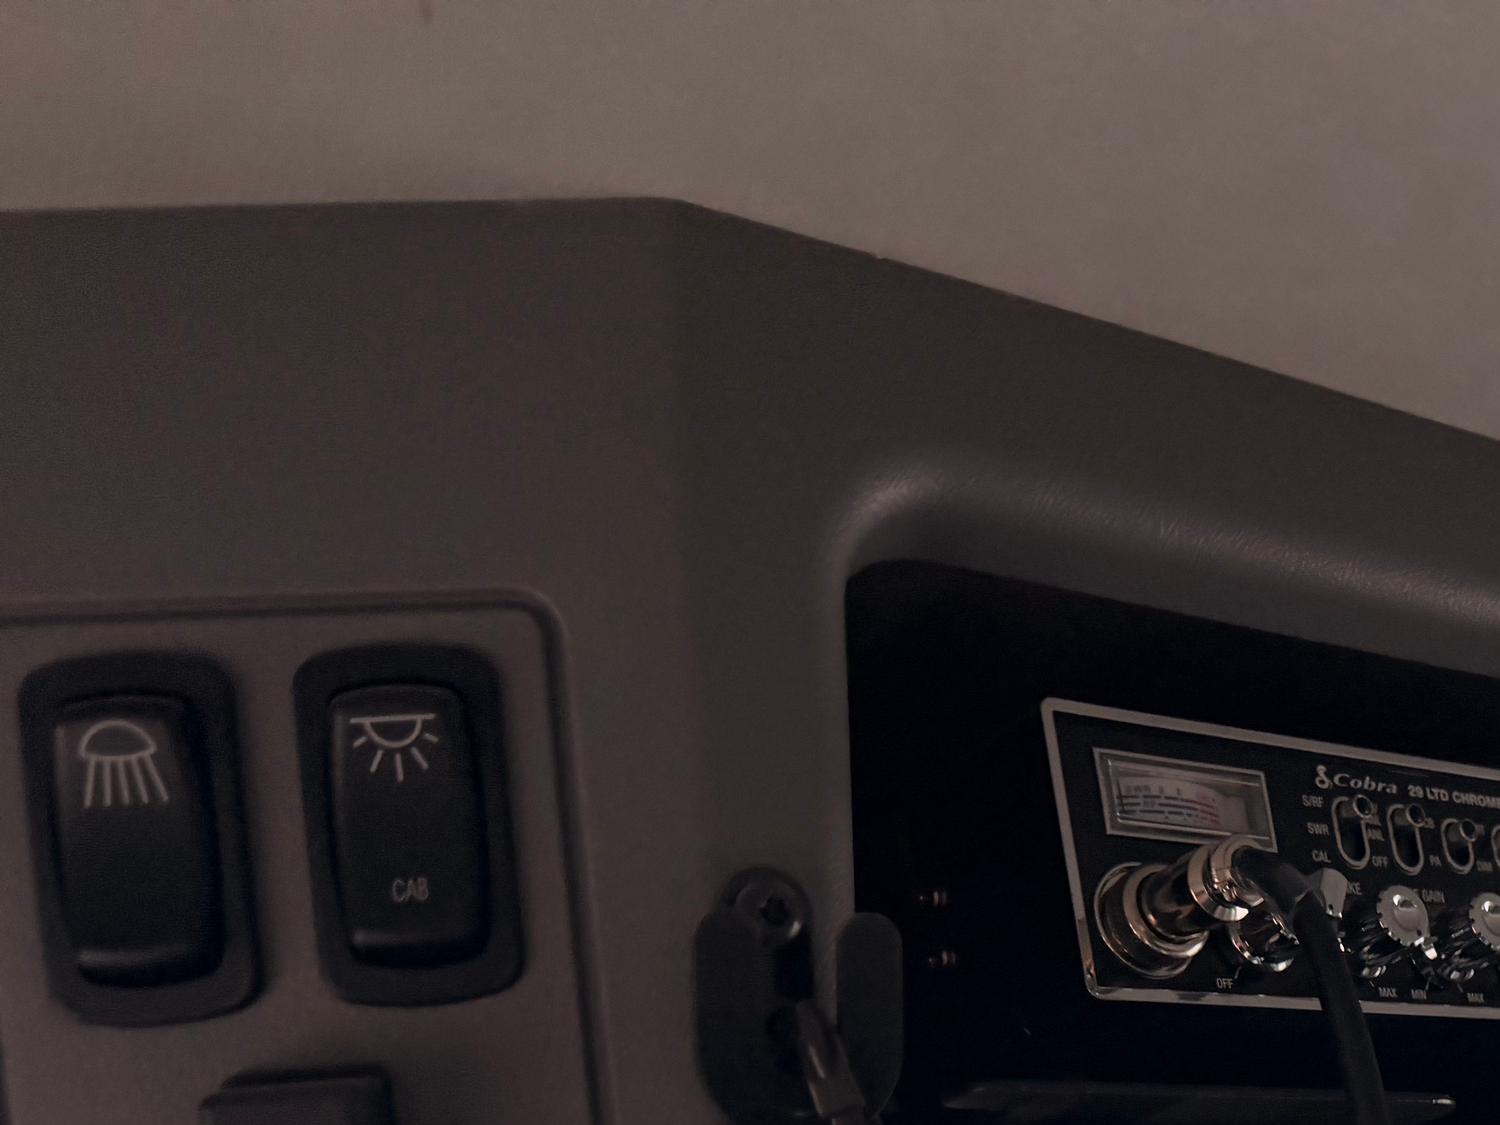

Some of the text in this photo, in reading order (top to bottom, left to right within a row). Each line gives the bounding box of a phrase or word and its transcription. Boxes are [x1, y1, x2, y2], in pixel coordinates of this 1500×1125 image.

[1333, 773, 1398, 794] Cobra
[1407, 784, 1424, 798] 29
[1426, 787, 1449, 802] LTD
[1312, 850, 1332, 863] CAL
[392, 877, 429, 903] CAB
[1216, 978, 1233, 989] OFF
